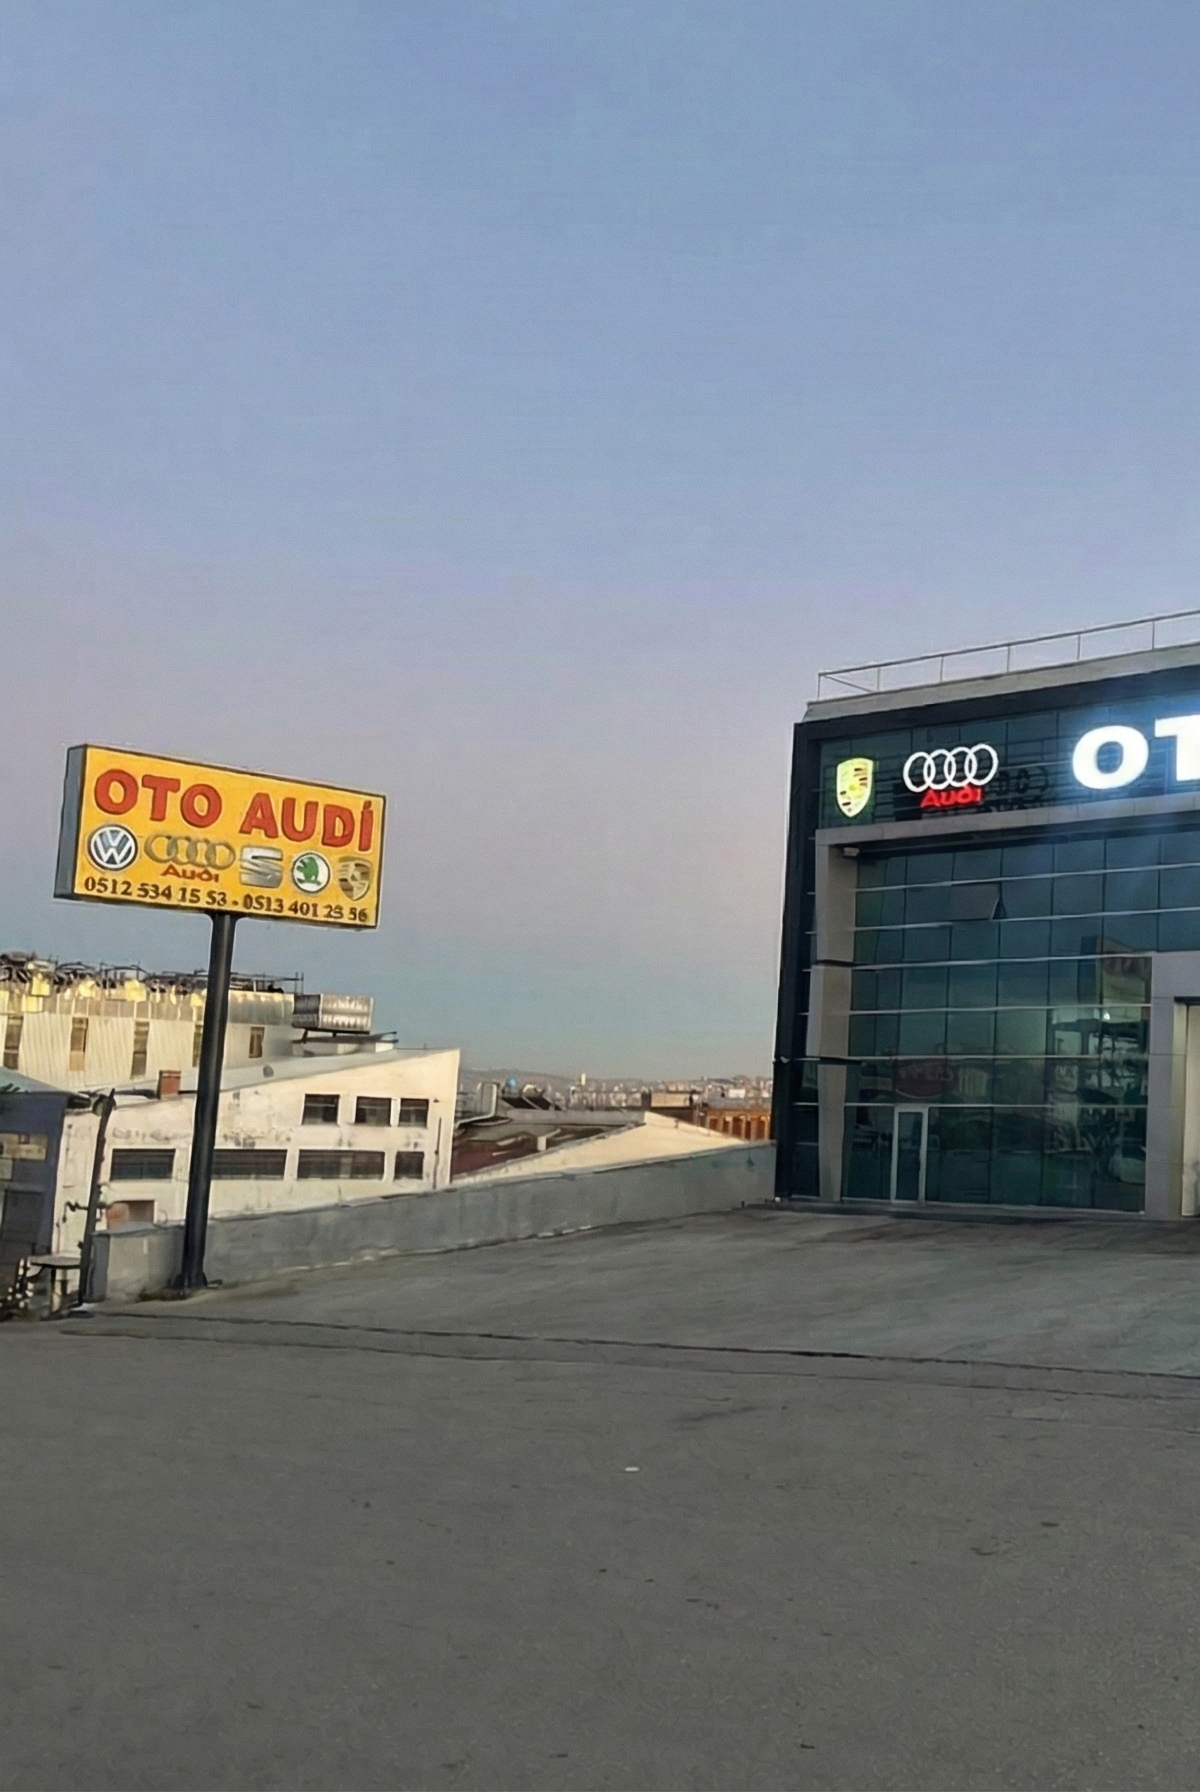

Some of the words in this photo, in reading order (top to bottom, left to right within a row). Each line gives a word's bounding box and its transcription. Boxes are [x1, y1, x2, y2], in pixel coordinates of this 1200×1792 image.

[94, 769, 223, 828] OTO
[239, 792, 374, 851] AUDİ
[920, 786, 983, 808] Audi
[161, 863, 220, 883] Audi
[84, 876, 133, 896] 0512
[137, 882, 173, 901] 534
[177, 886, 202, 905] 15
[242, 893, 284, 914] 0513
[288, 900, 319, 918] 401
